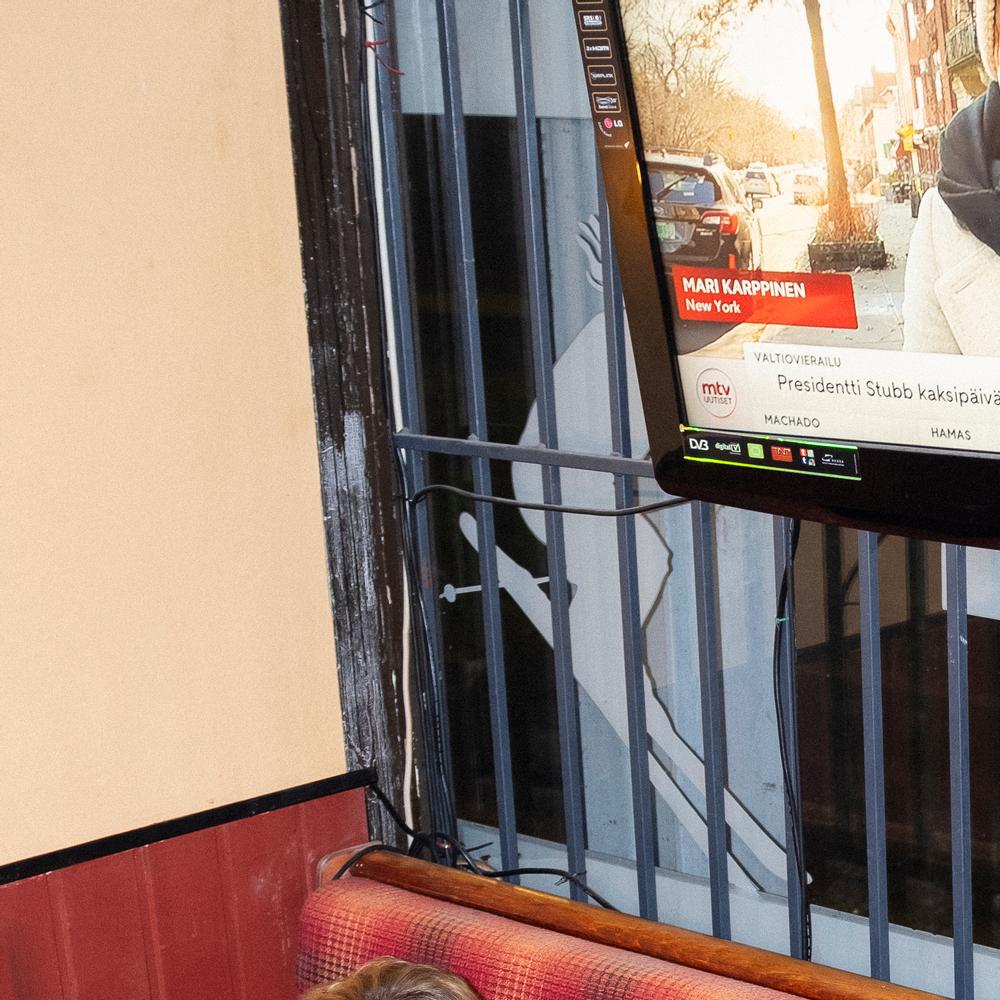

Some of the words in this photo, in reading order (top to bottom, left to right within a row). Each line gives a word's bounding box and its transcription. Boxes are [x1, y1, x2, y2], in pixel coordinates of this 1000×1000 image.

[682, 277, 719, 294] MARI
[722, 281, 806, 298] KARPPINEN
[685, 299, 712, 312] New
[713, 300, 741, 314] York
[754, 353, 842, 367] VALTIOVIERAILU
[702, 381, 730, 396] mtv
[777, 374, 861, 396] Presidentti
[866, 380, 913, 400] Stubb
[703, 396, 732, 405] UUTISET
[764, 414, 821, 428] MACHADO
[931, 427, 972, 441] HAMAS
